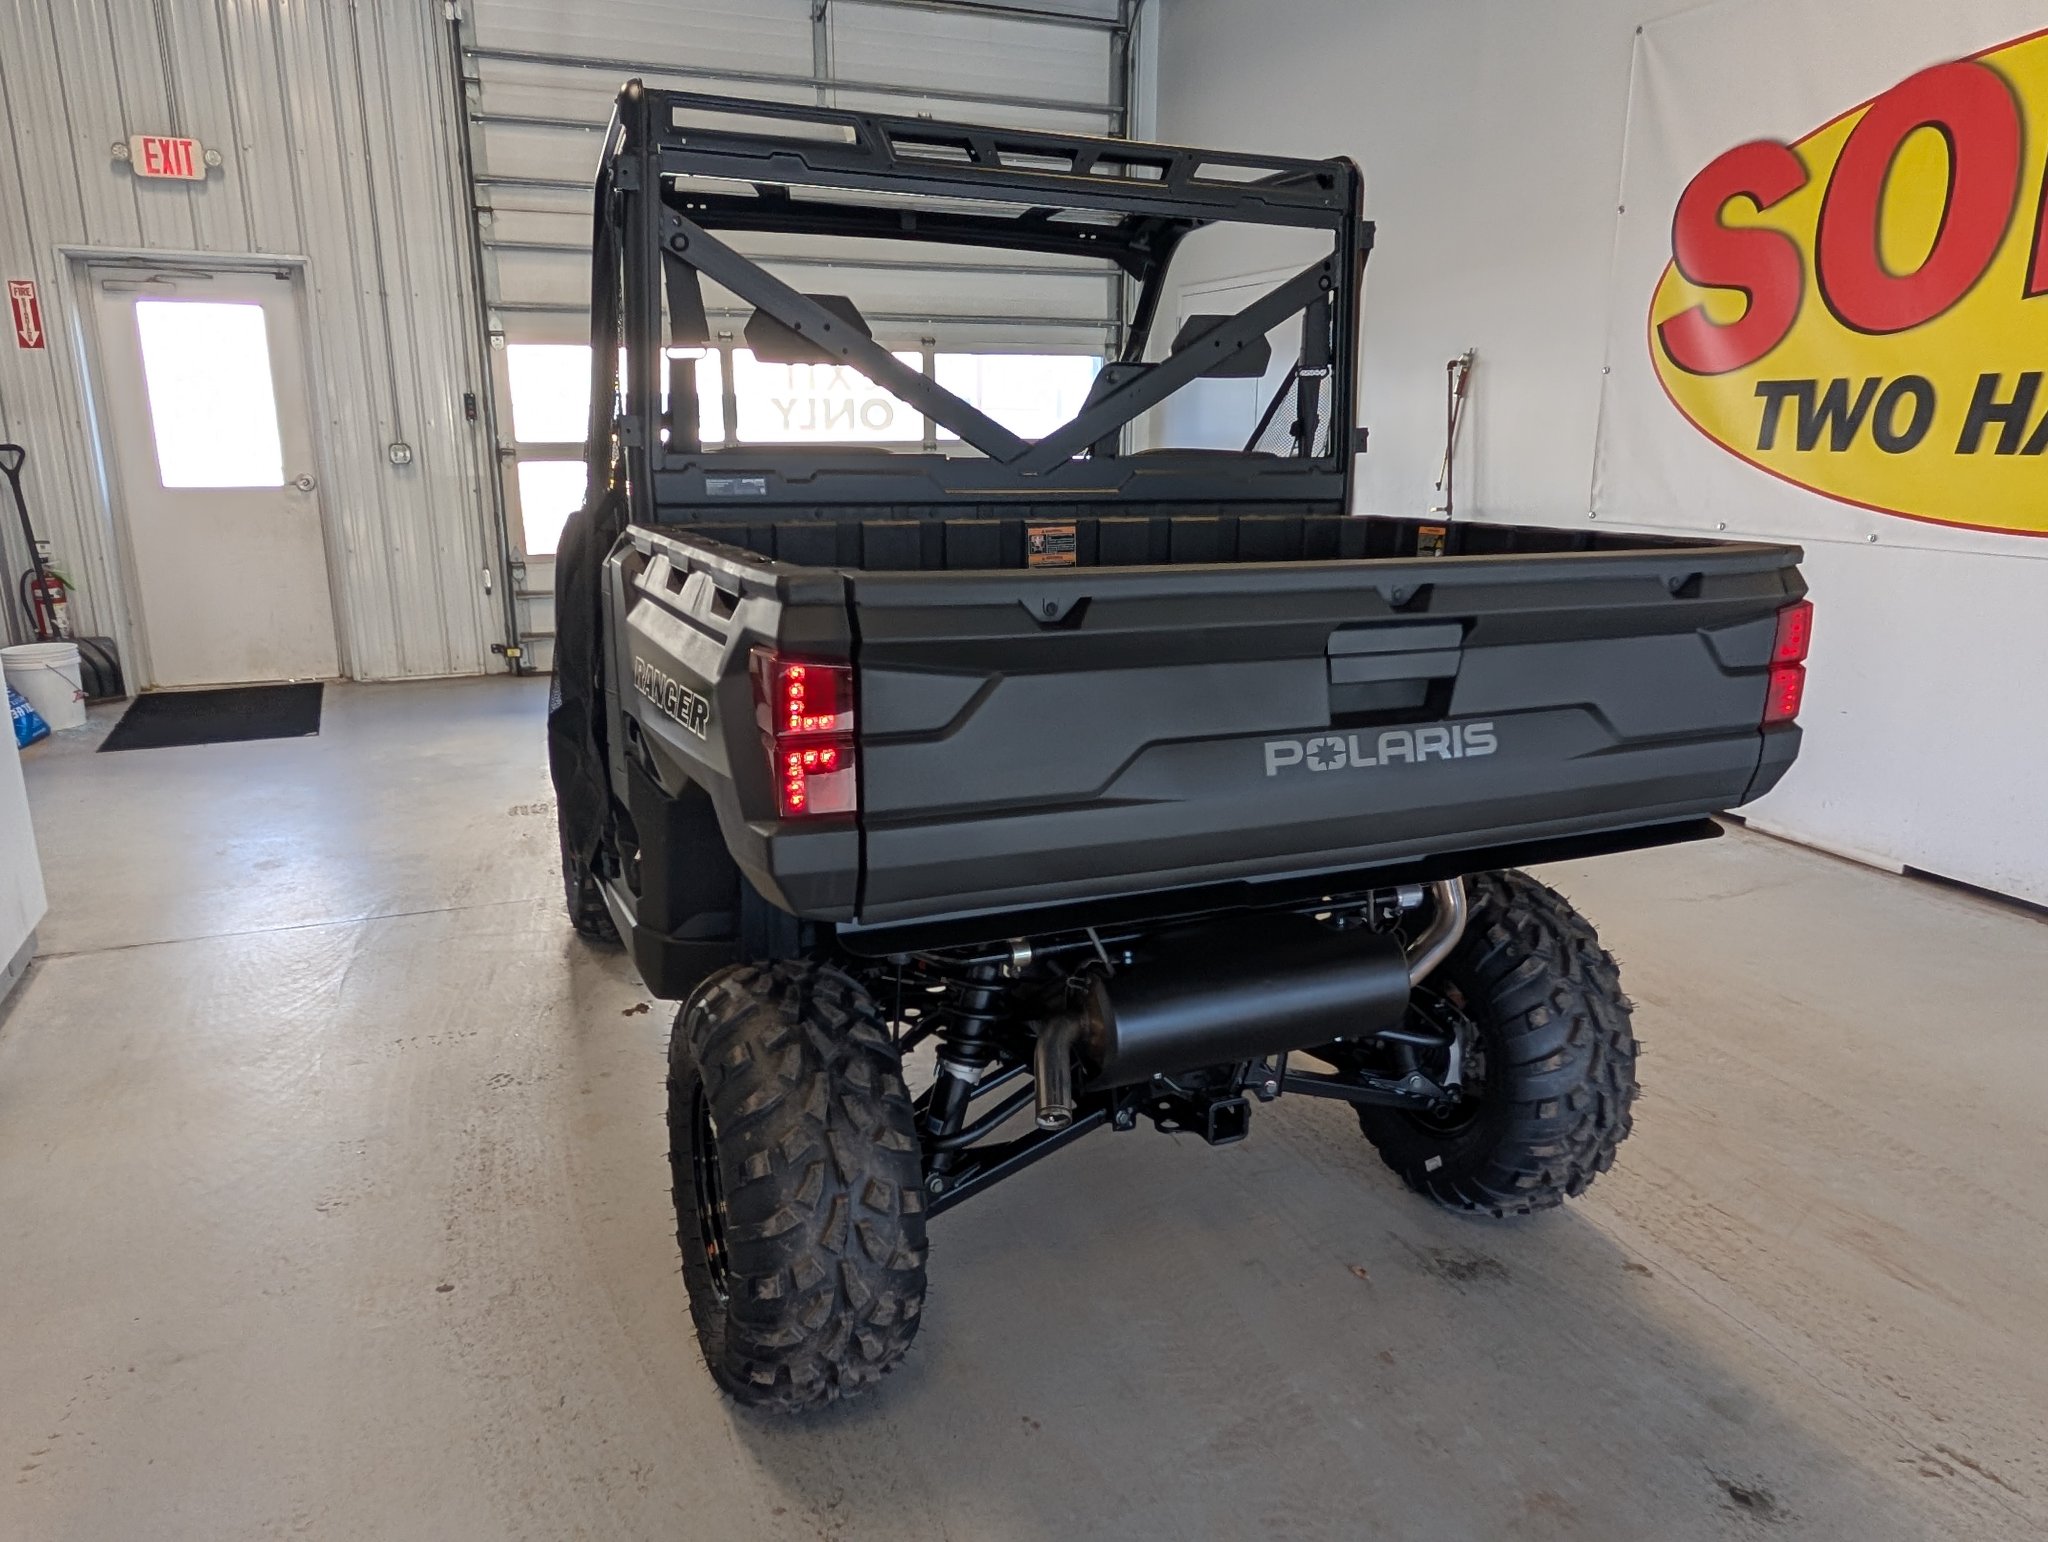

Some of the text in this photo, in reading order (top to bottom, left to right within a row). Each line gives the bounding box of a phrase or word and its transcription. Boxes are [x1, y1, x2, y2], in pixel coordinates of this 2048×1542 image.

[142, 137, 194, 177] EXIT
[1657, 60, 2048, 376] SO
[13, 286, 32, 297] FIRE
[1754, 374, 1936, 454] TWO
[634, 656, 710, 741] RANGER
[1264, 722, 1498, 777] POLARIS
